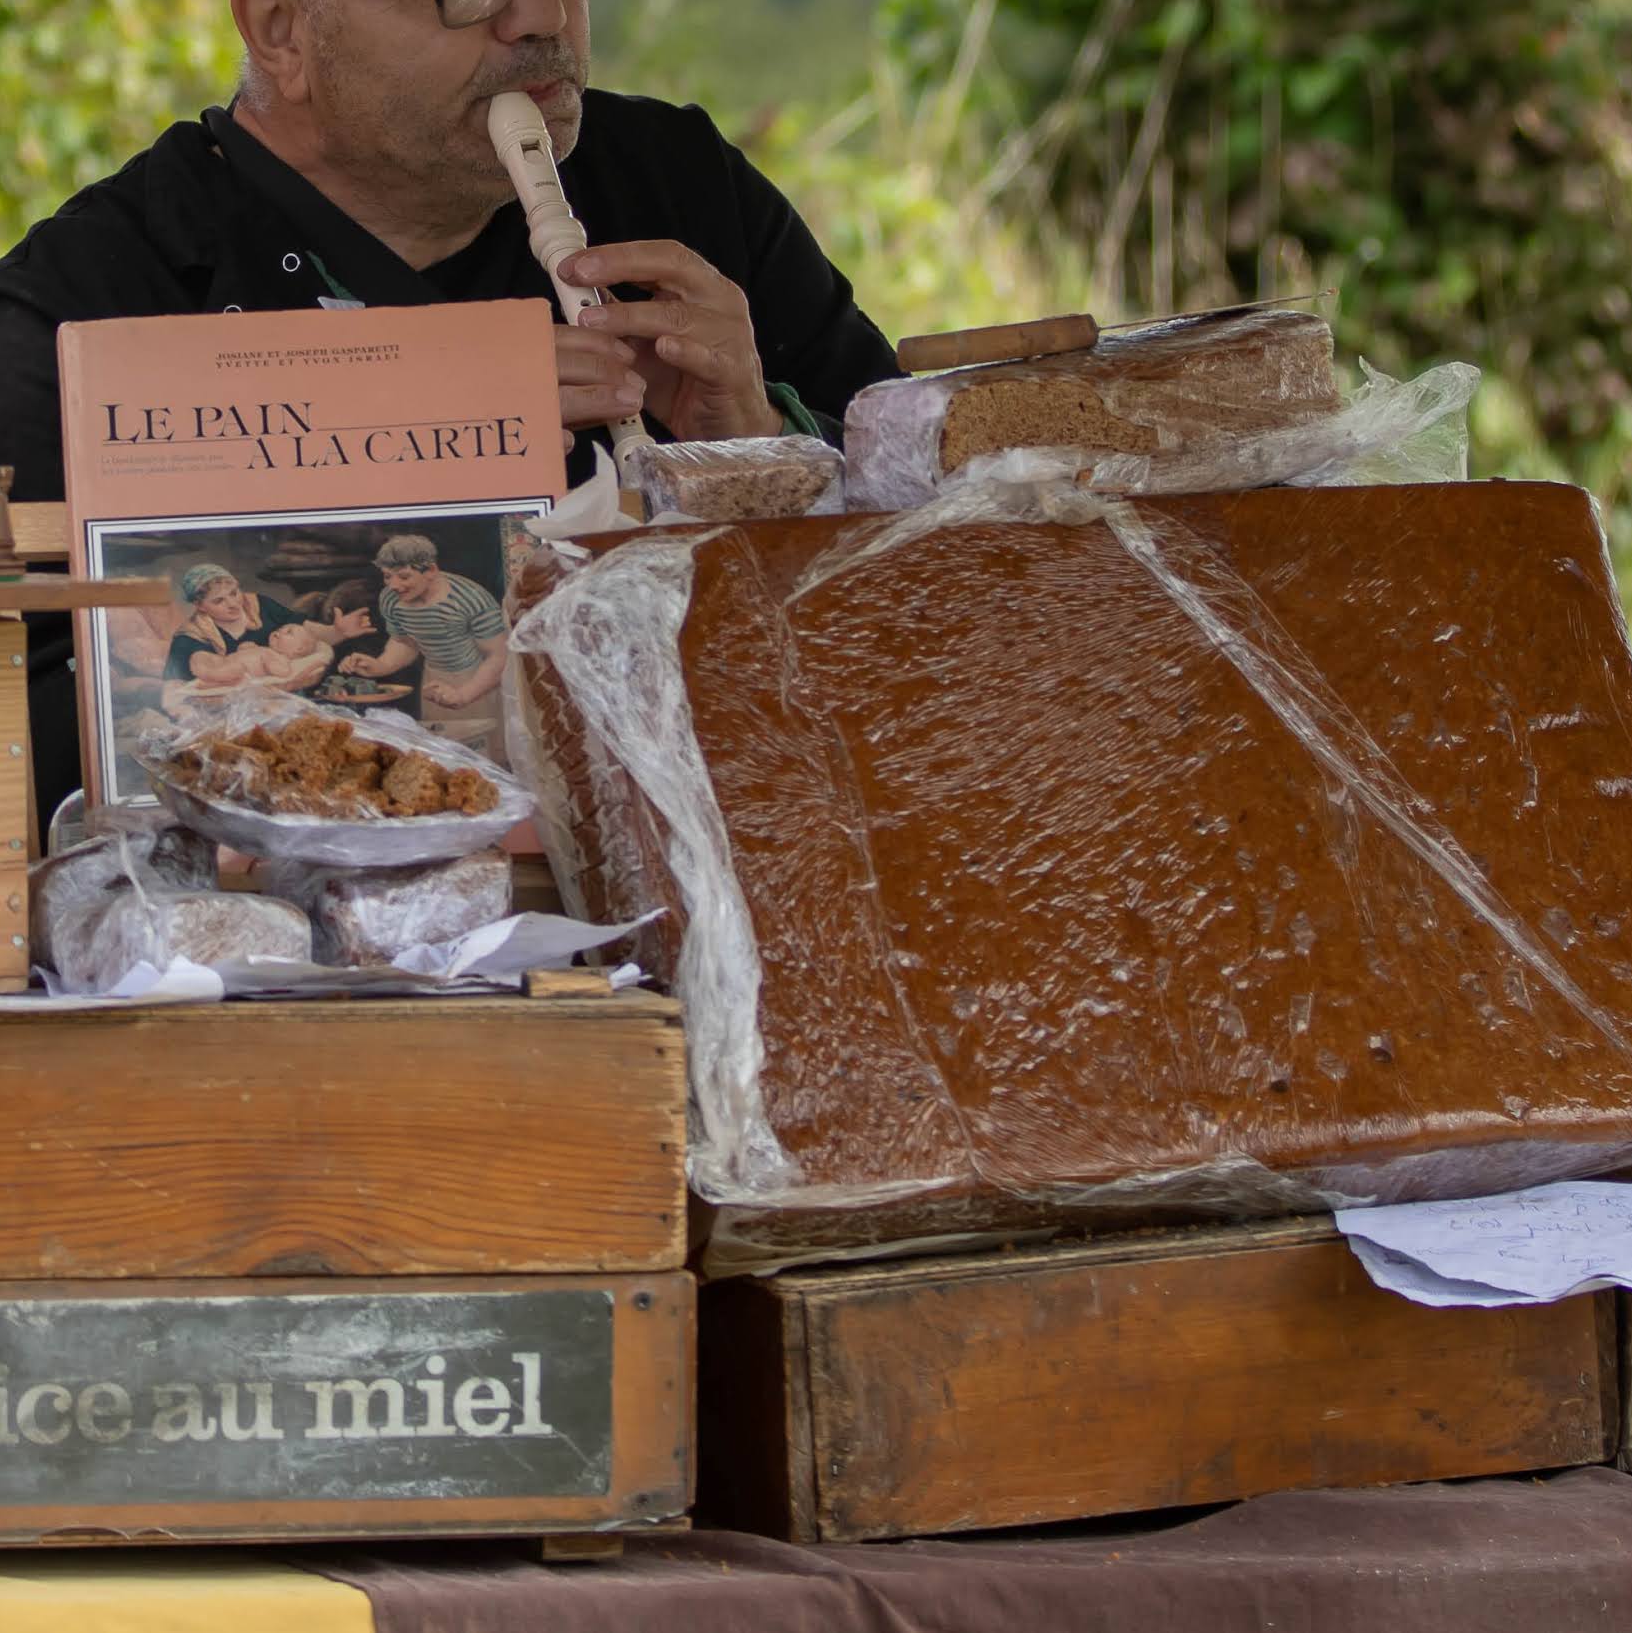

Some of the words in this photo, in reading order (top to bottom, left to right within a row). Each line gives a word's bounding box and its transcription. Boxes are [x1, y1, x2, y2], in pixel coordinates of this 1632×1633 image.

[215, 360, 269, 368] YVETTE
[278, 358, 294, 366] ET
[303, 356, 340, 366] YVON
[267, 350, 280, 358] ET
[286, 348, 328, 357] JOSEPH
[99, 403, 175, 443] LE
[192, 401, 312, 438] PAIN
[291, 433, 351, 468] LA
[364, 417, 529, 463] CARTE
[152, 1378, 283, 1442] au
[310, 1352, 554, 1439] miel
